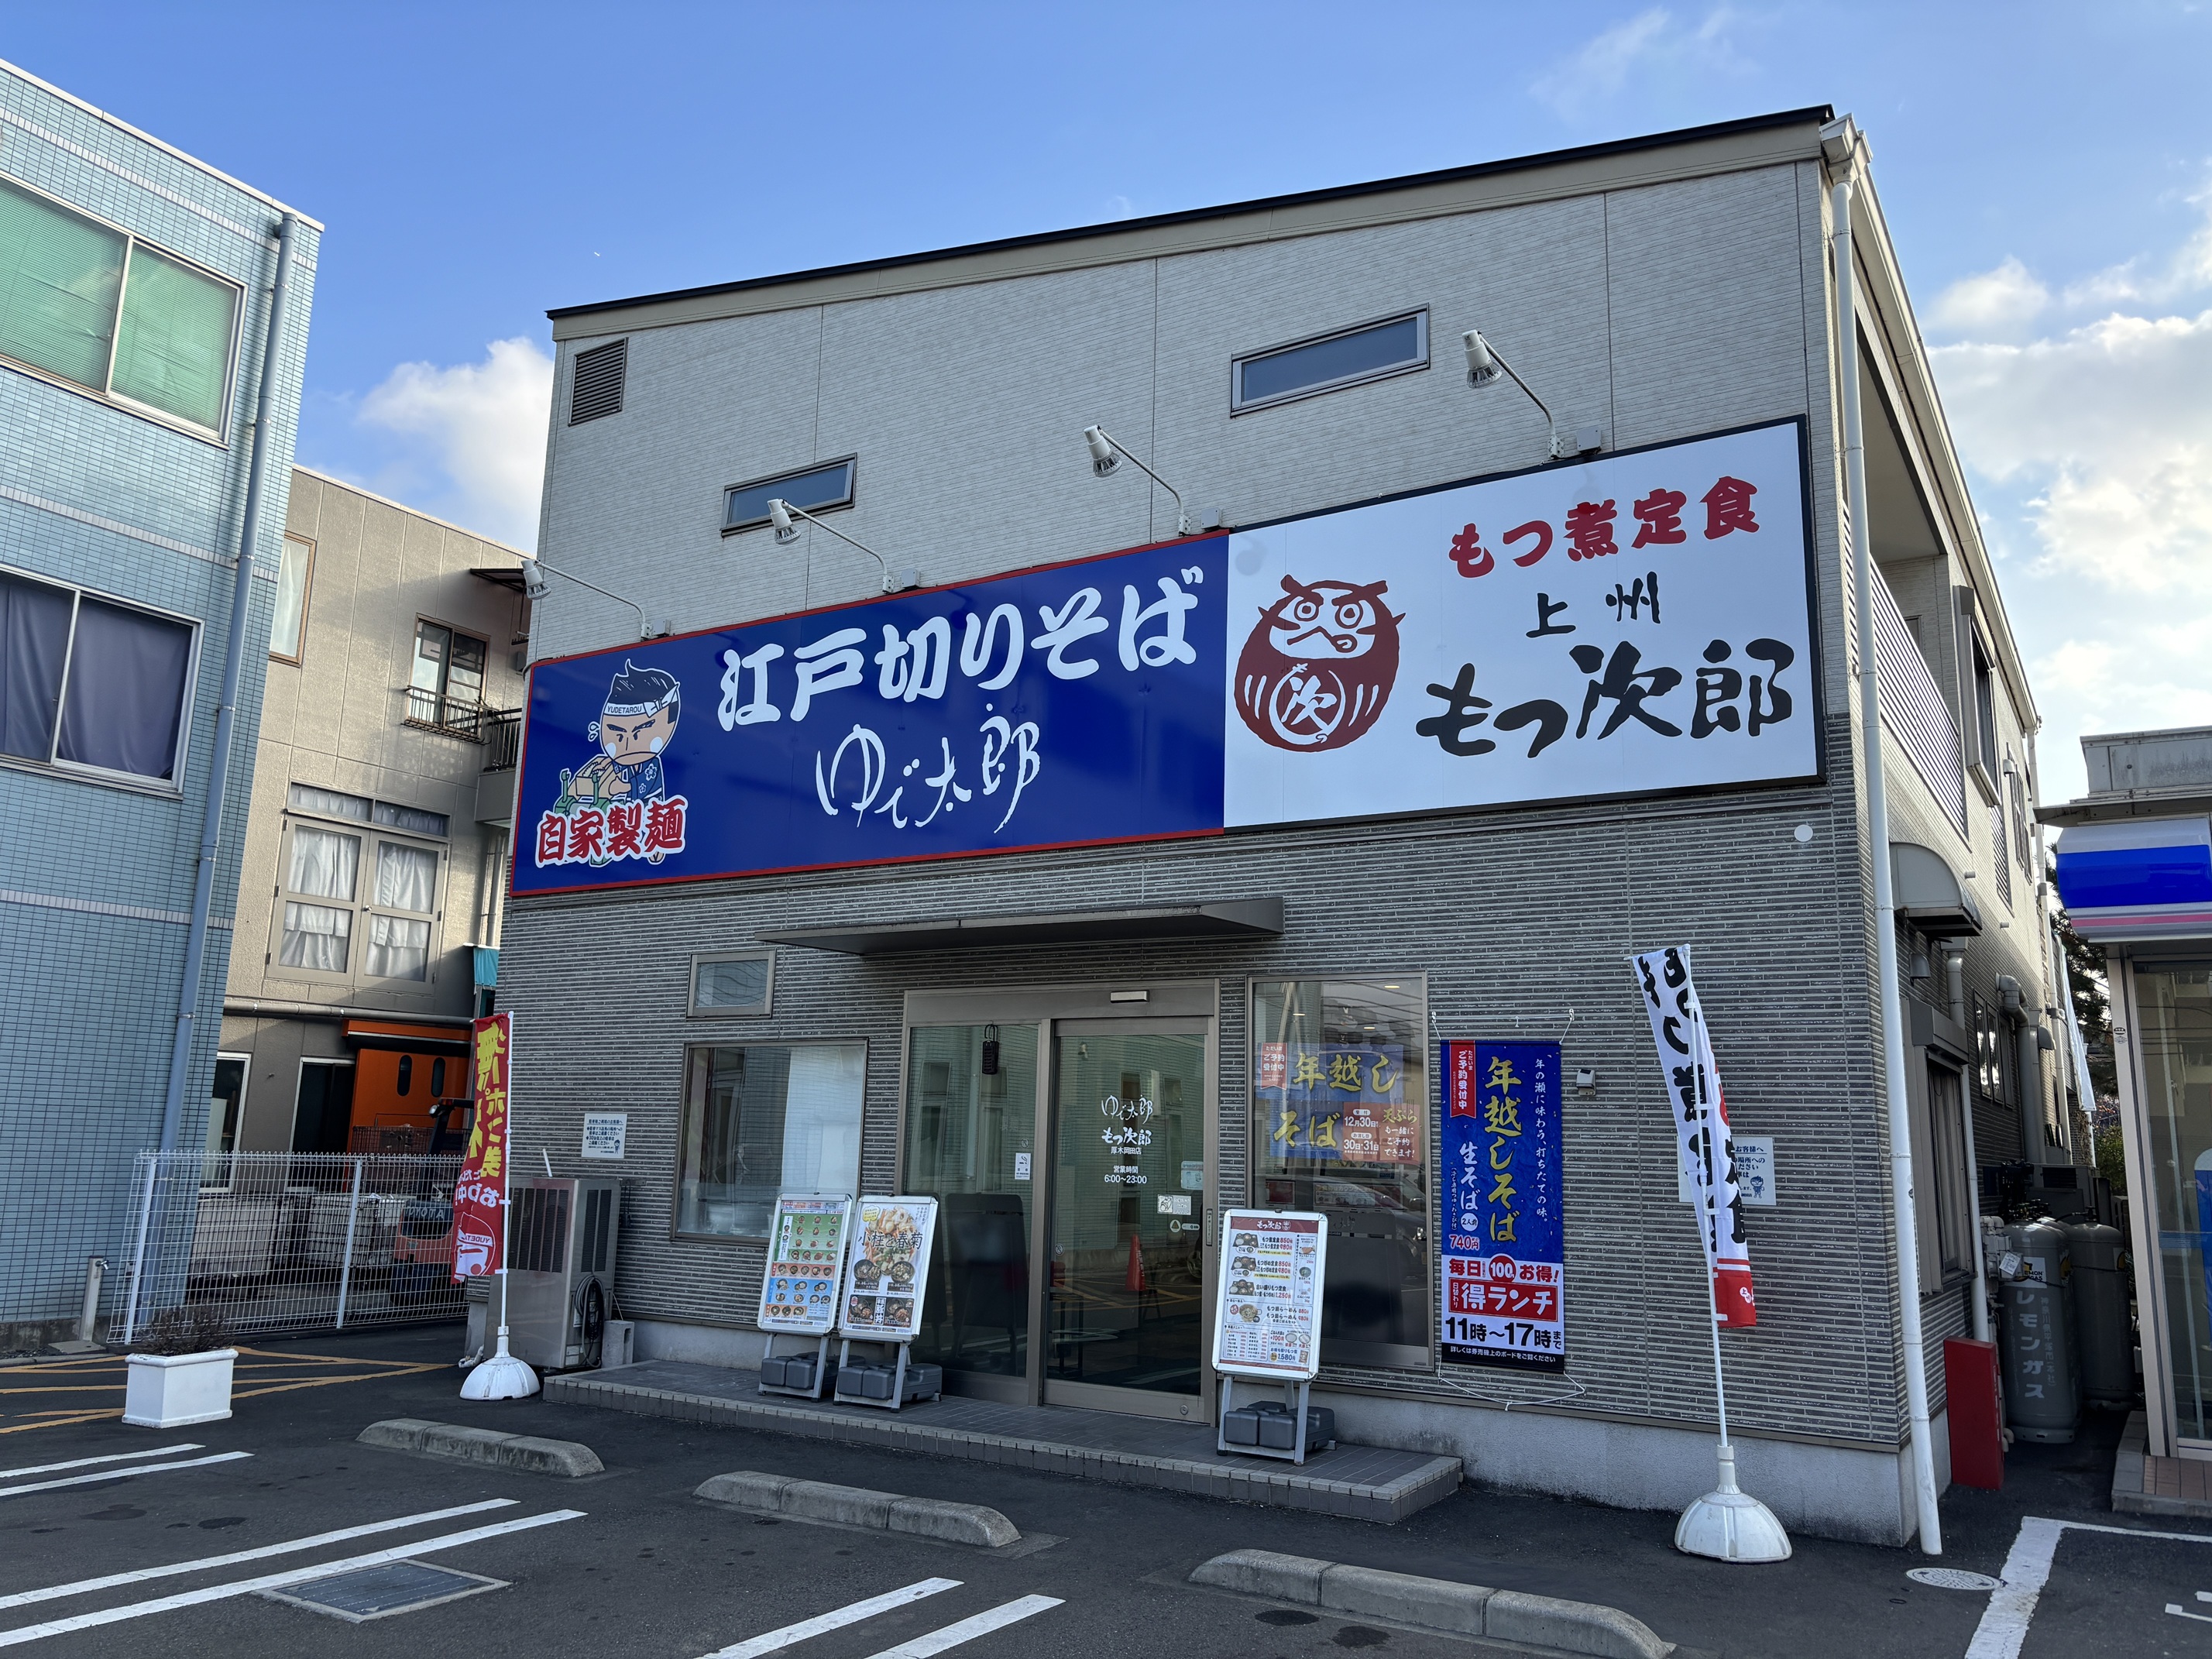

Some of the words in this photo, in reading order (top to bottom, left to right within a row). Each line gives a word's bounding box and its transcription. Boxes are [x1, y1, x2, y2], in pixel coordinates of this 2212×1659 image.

[1448, 476, 1760, 578] もつ煮定食
[1526, 571, 1661, 638] 上州
[717, 565, 1204, 732] 江戸切りそば
[607, 705, 642, 714] YUDETAROU
[1416, 638, 1795, 759] もつ次郎
[816, 702, 1040, 834] ゆで太郎
[536, 796, 688, 867] 自家製麺
[1293, 1053, 1398, 1094] 年越し
[1458, 1049, 1468, 1110] ご予約受付中
[1101, 1094, 1153, 1124] ゆで太郎
[1382, 1108, 1417, 1124] 天ぷら
[1101, 1127, 1152, 1146] もつ次郎
[1274, 1111, 1340, 1147] そば
[1385, 1126, 1414, 1135] も一緒に
[1387, 1137, 1410, 1146] ご予約
[1534, 1058, 1549, 1223] 年の瀬に味わう、打ちたての味。
[1385, 1149, 1416, 1158] できます!
[1484, 1056, 1523, 1242] 年越しそば
[1113, 1166, 1139, 1174] 営業時間
[1459, 1141, 1480, 1211] 生そば
[1462, 1218, 1478, 1227] 2人前
[857, 1230, 923, 1250] 小柱と春菊
[1450, 1235, 1480, 1250] 740円
[1449, 1259, 1481, 1277] 毎日
[1520, 1264, 1559, 1283] お得!
[1462, 1283, 1553, 1315] 得ランチ
[2016, 1290, 2045, 1399] レモンガス
